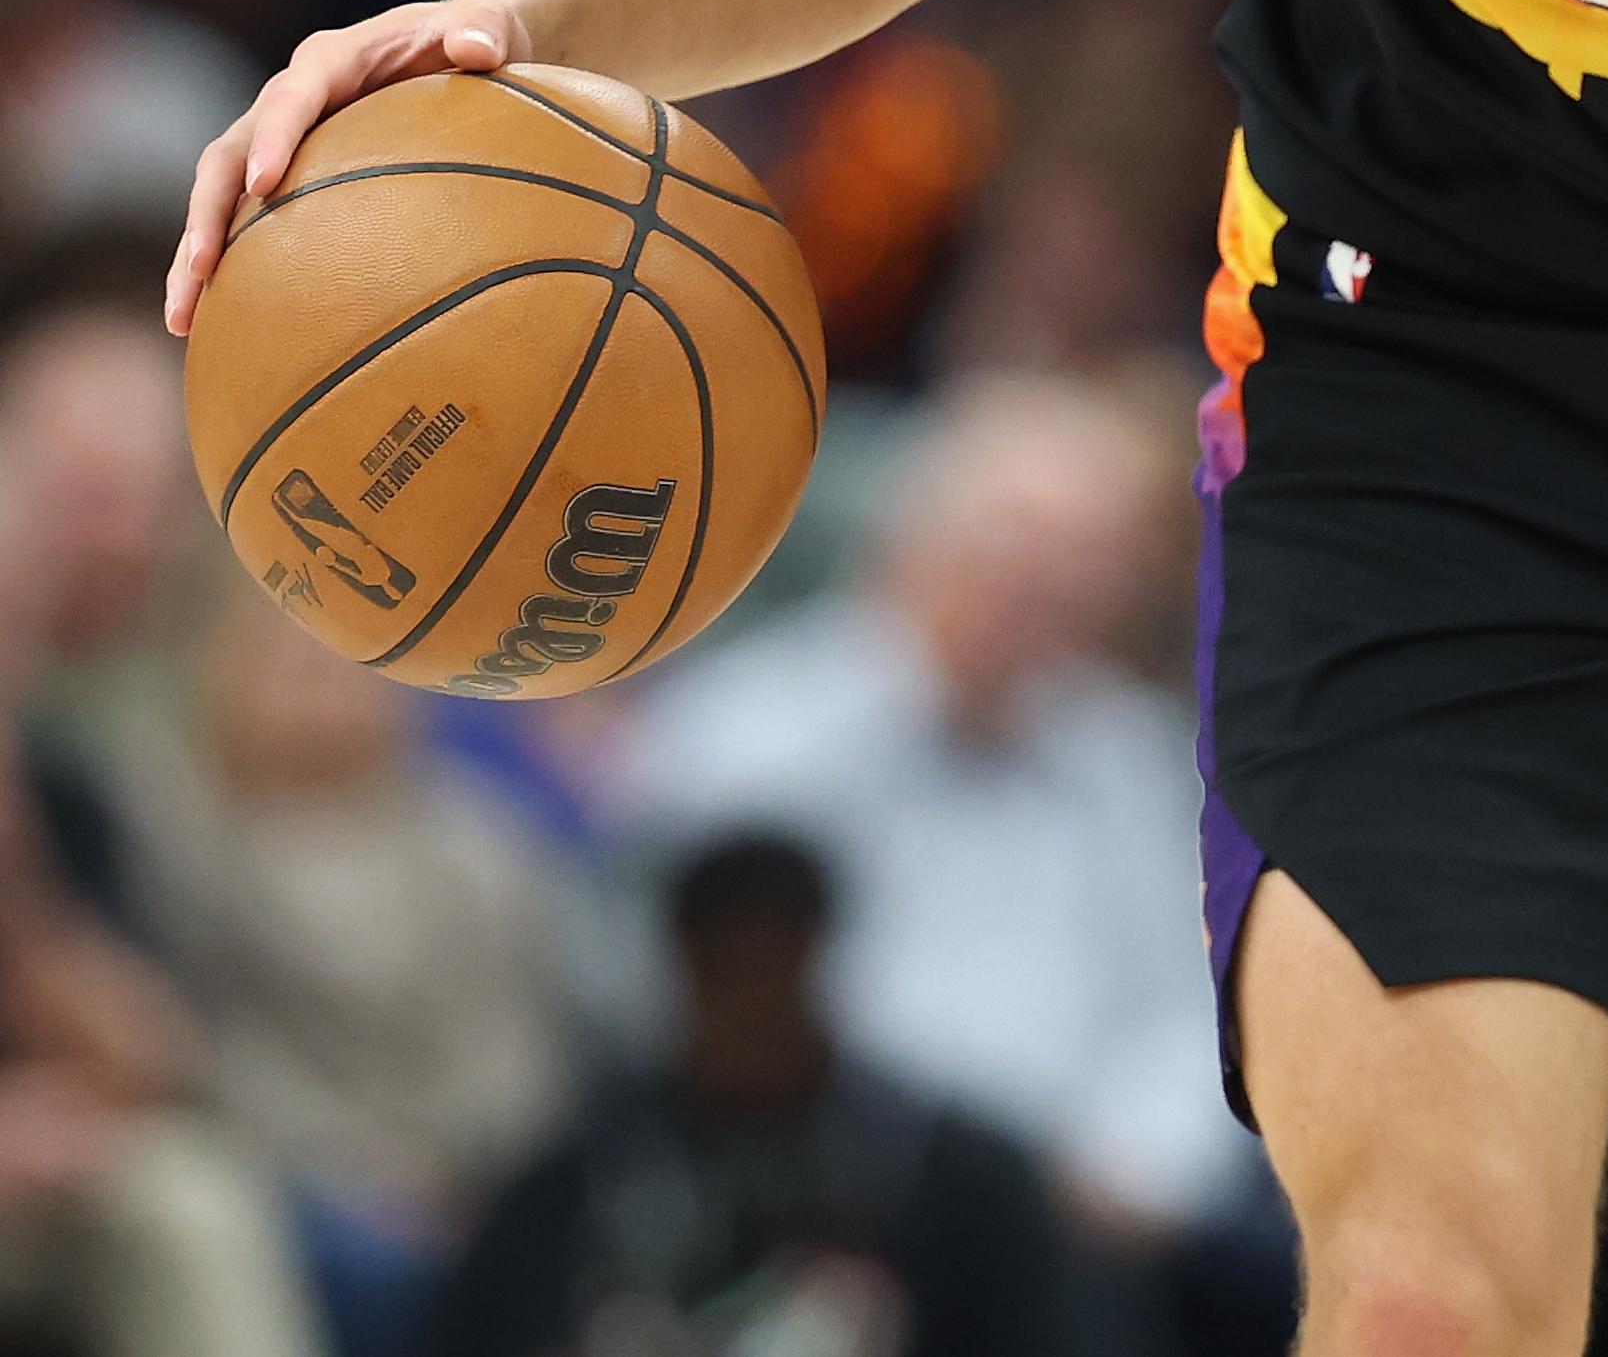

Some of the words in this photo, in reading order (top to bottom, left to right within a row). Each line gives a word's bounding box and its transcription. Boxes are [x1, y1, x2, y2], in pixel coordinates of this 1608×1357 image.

[408, 402, 467, 461] OFFICIAL
[358, 478, 396, 514] BALL
[380, 449, 423, 492] GAME
[424, 478, 678, 701] Wilso
